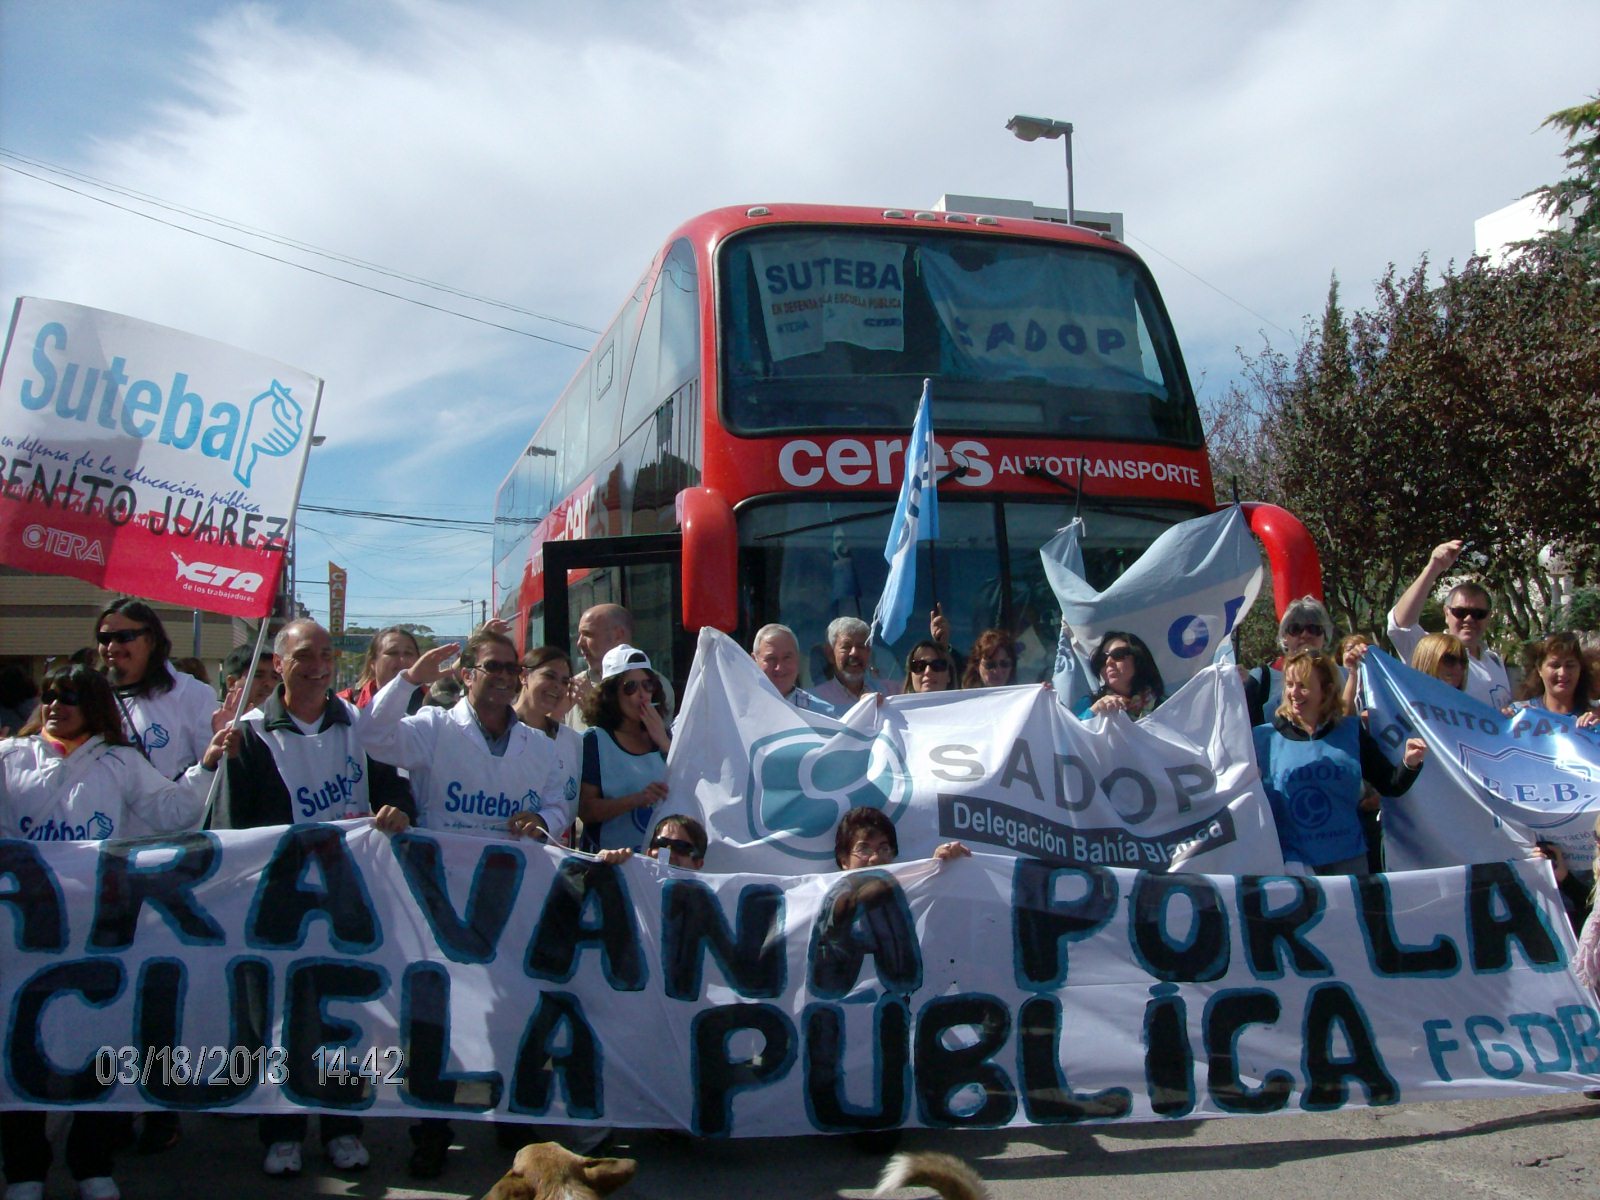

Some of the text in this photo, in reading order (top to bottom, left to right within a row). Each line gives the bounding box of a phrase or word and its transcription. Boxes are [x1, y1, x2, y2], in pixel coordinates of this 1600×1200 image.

[766, 257, 902, 295] SUTEBA
[20, 321, 241, 462] Suteba
[17, 434, 69, 460] defensa
[75, 450, 94, 468] de
[99, 455, 117, 475] la
[123, 465, 205, 499] educación
[998, 455, 1201, 488] AUTOTRANSPORTE
[22, 524, 105, 566] CTERA
[149, 495, 288, 552] JUAREZ
[182, 582, 255, 603] de los trabajadores
[186, 561, 263, 593] CTA
[1380, 701, 1499, 749] DITRITO
[928, 738, 1218, 825] SADOP
[1281, 764, 1348, 783] ADOP
[296, 774, 353, 818] Suteb
[444, 781, 520, 818] Suteba
[953, 802, 1067, 857] Delegación
[1073, 834, 1140, 863] Bahía
[4, 954, 605, 1120] CUELA
